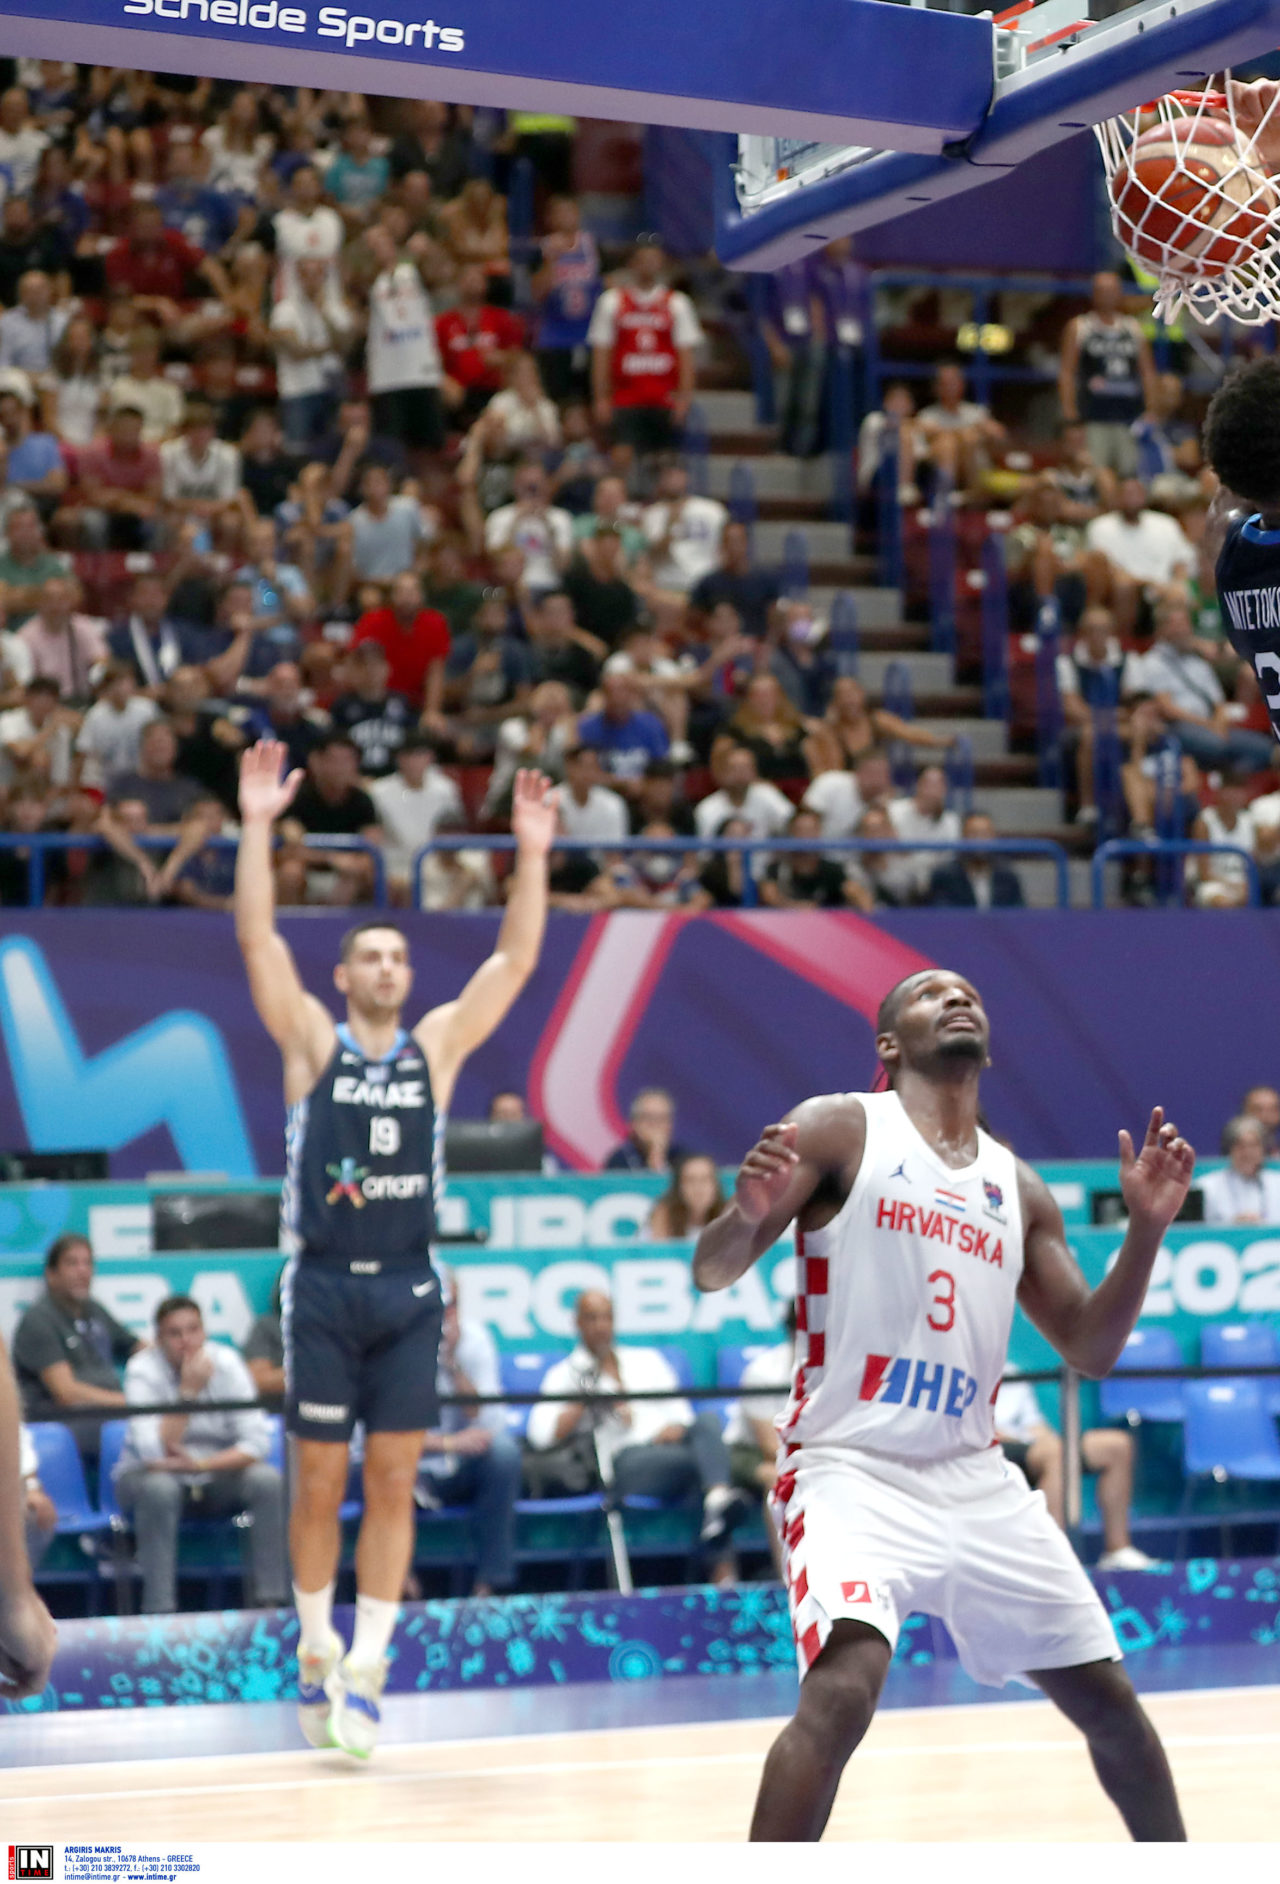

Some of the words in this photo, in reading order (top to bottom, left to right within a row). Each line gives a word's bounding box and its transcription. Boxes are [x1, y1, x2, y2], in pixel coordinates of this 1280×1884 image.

[317, 6, 465, 52] Sports
[368, 1115, 400, 1156] 19
[876, 1197, 1004, 1270] HRVATSKA
[926, 1269, 956, 1332] 3
[907, 1359, 977, 1419] HEP
